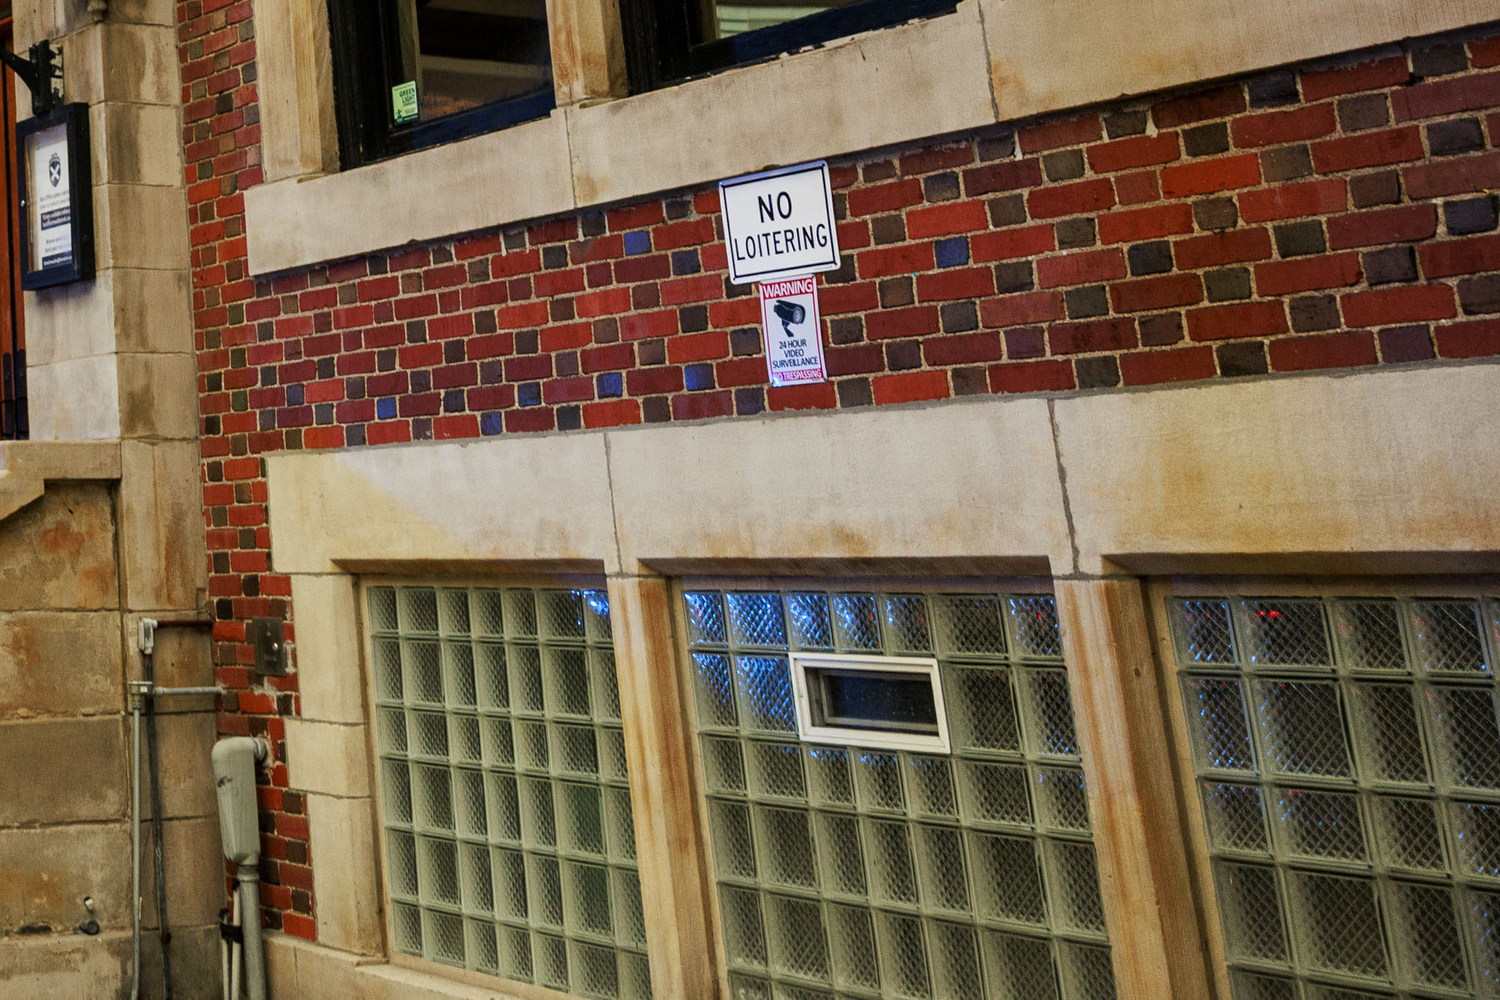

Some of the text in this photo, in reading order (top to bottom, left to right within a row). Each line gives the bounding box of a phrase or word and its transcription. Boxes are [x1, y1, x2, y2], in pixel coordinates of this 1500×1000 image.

[757, 191, 793, 224] NO
[734, 223, 828, 261] LOITERING
[763, 278, 813, 299] WARNING
[779, 339, 807, 350] 24 HOUR
[783, 348, 805, 358] VIDEO
[772, 357, 819, 369] SURVEILLANCE
[783, 369, 822, 381] TRESPASSING
